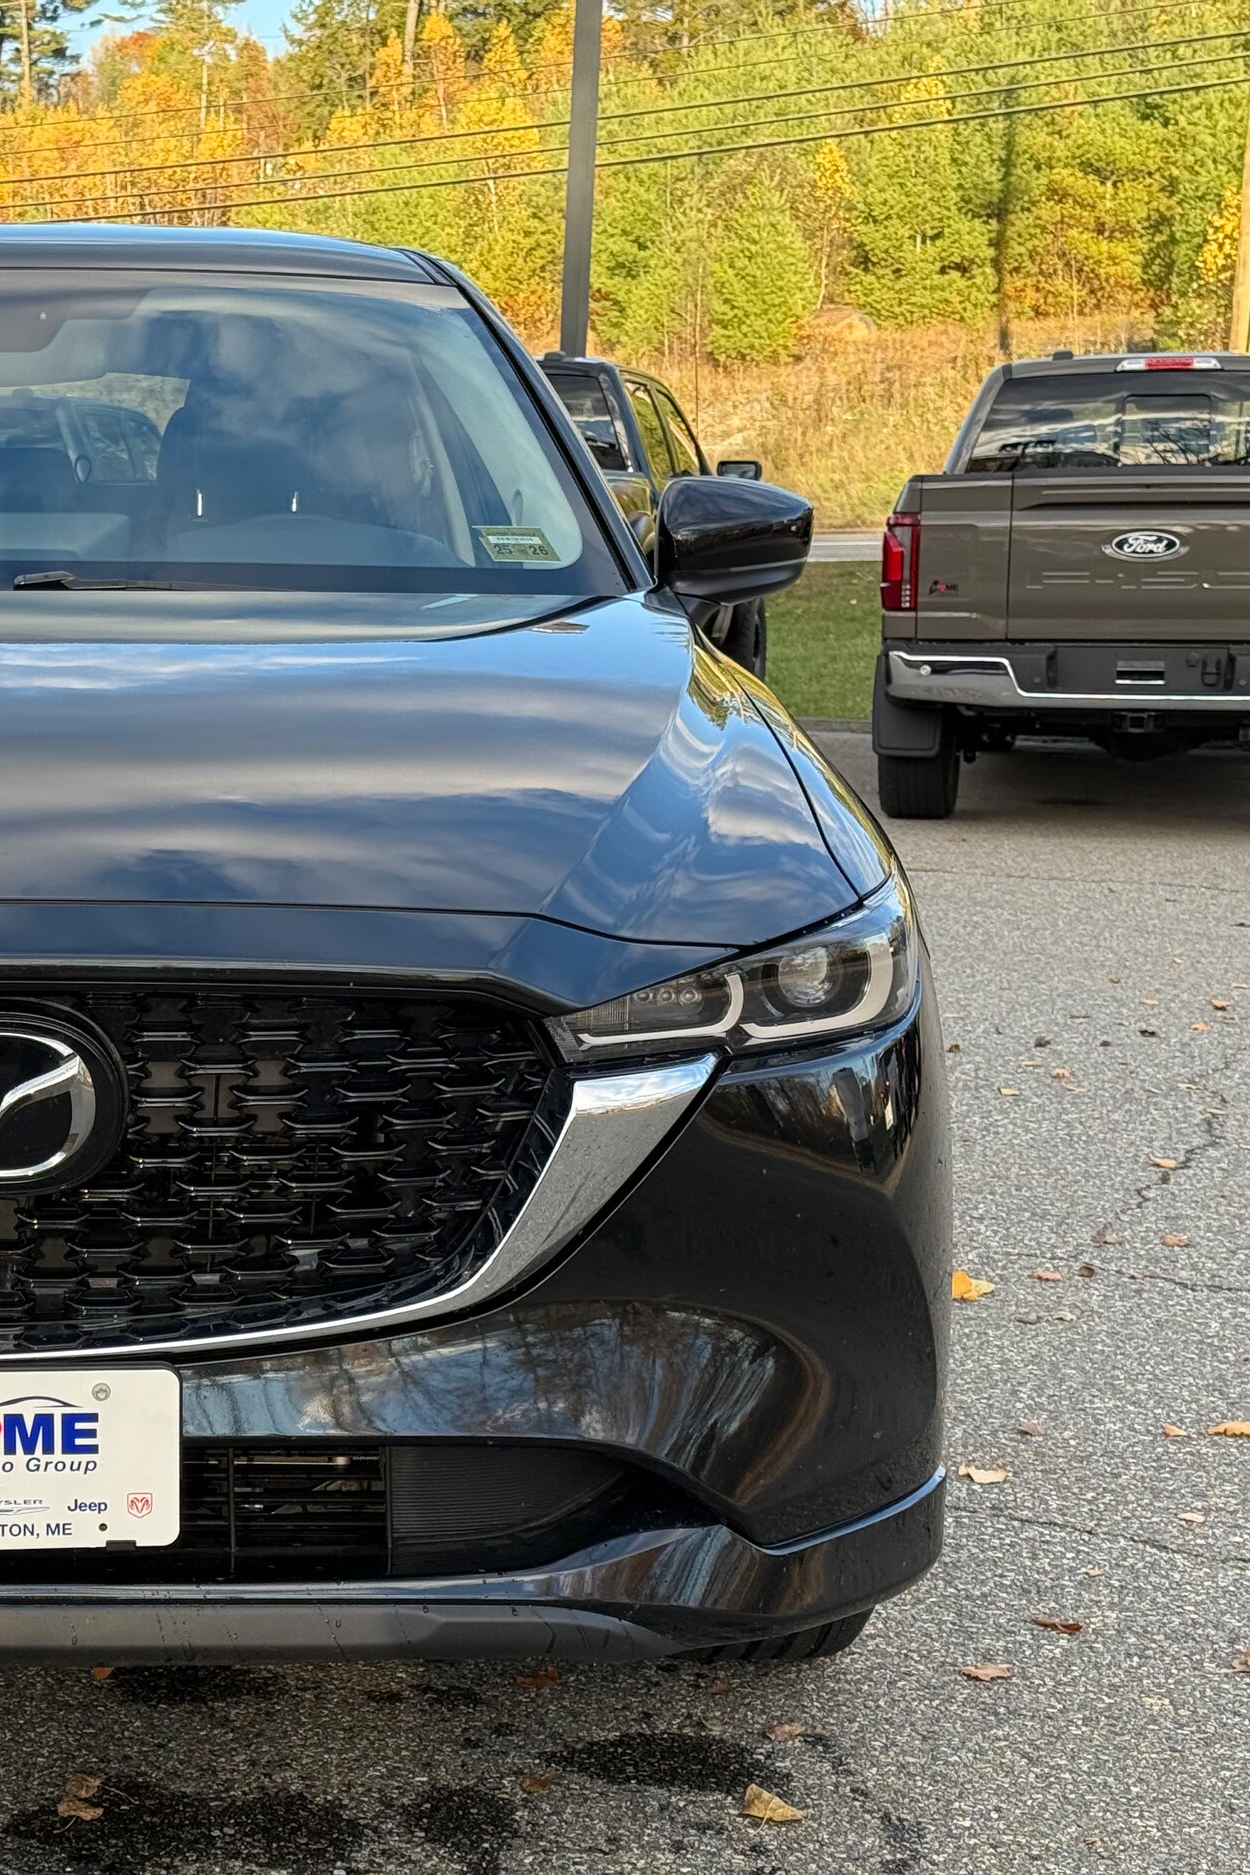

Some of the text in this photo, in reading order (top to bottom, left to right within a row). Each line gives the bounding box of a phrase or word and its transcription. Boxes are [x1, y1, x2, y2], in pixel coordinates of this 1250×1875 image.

[493, 544, 513, 555] 25
[529, 544, 549, 556] 26
[1122, 534, 1167, 554] Ford
[25, 1455, 98, 1475] Group
[67, 1498, 108, 1514] Jeep
[45, 1522, 73, 1536] ME
